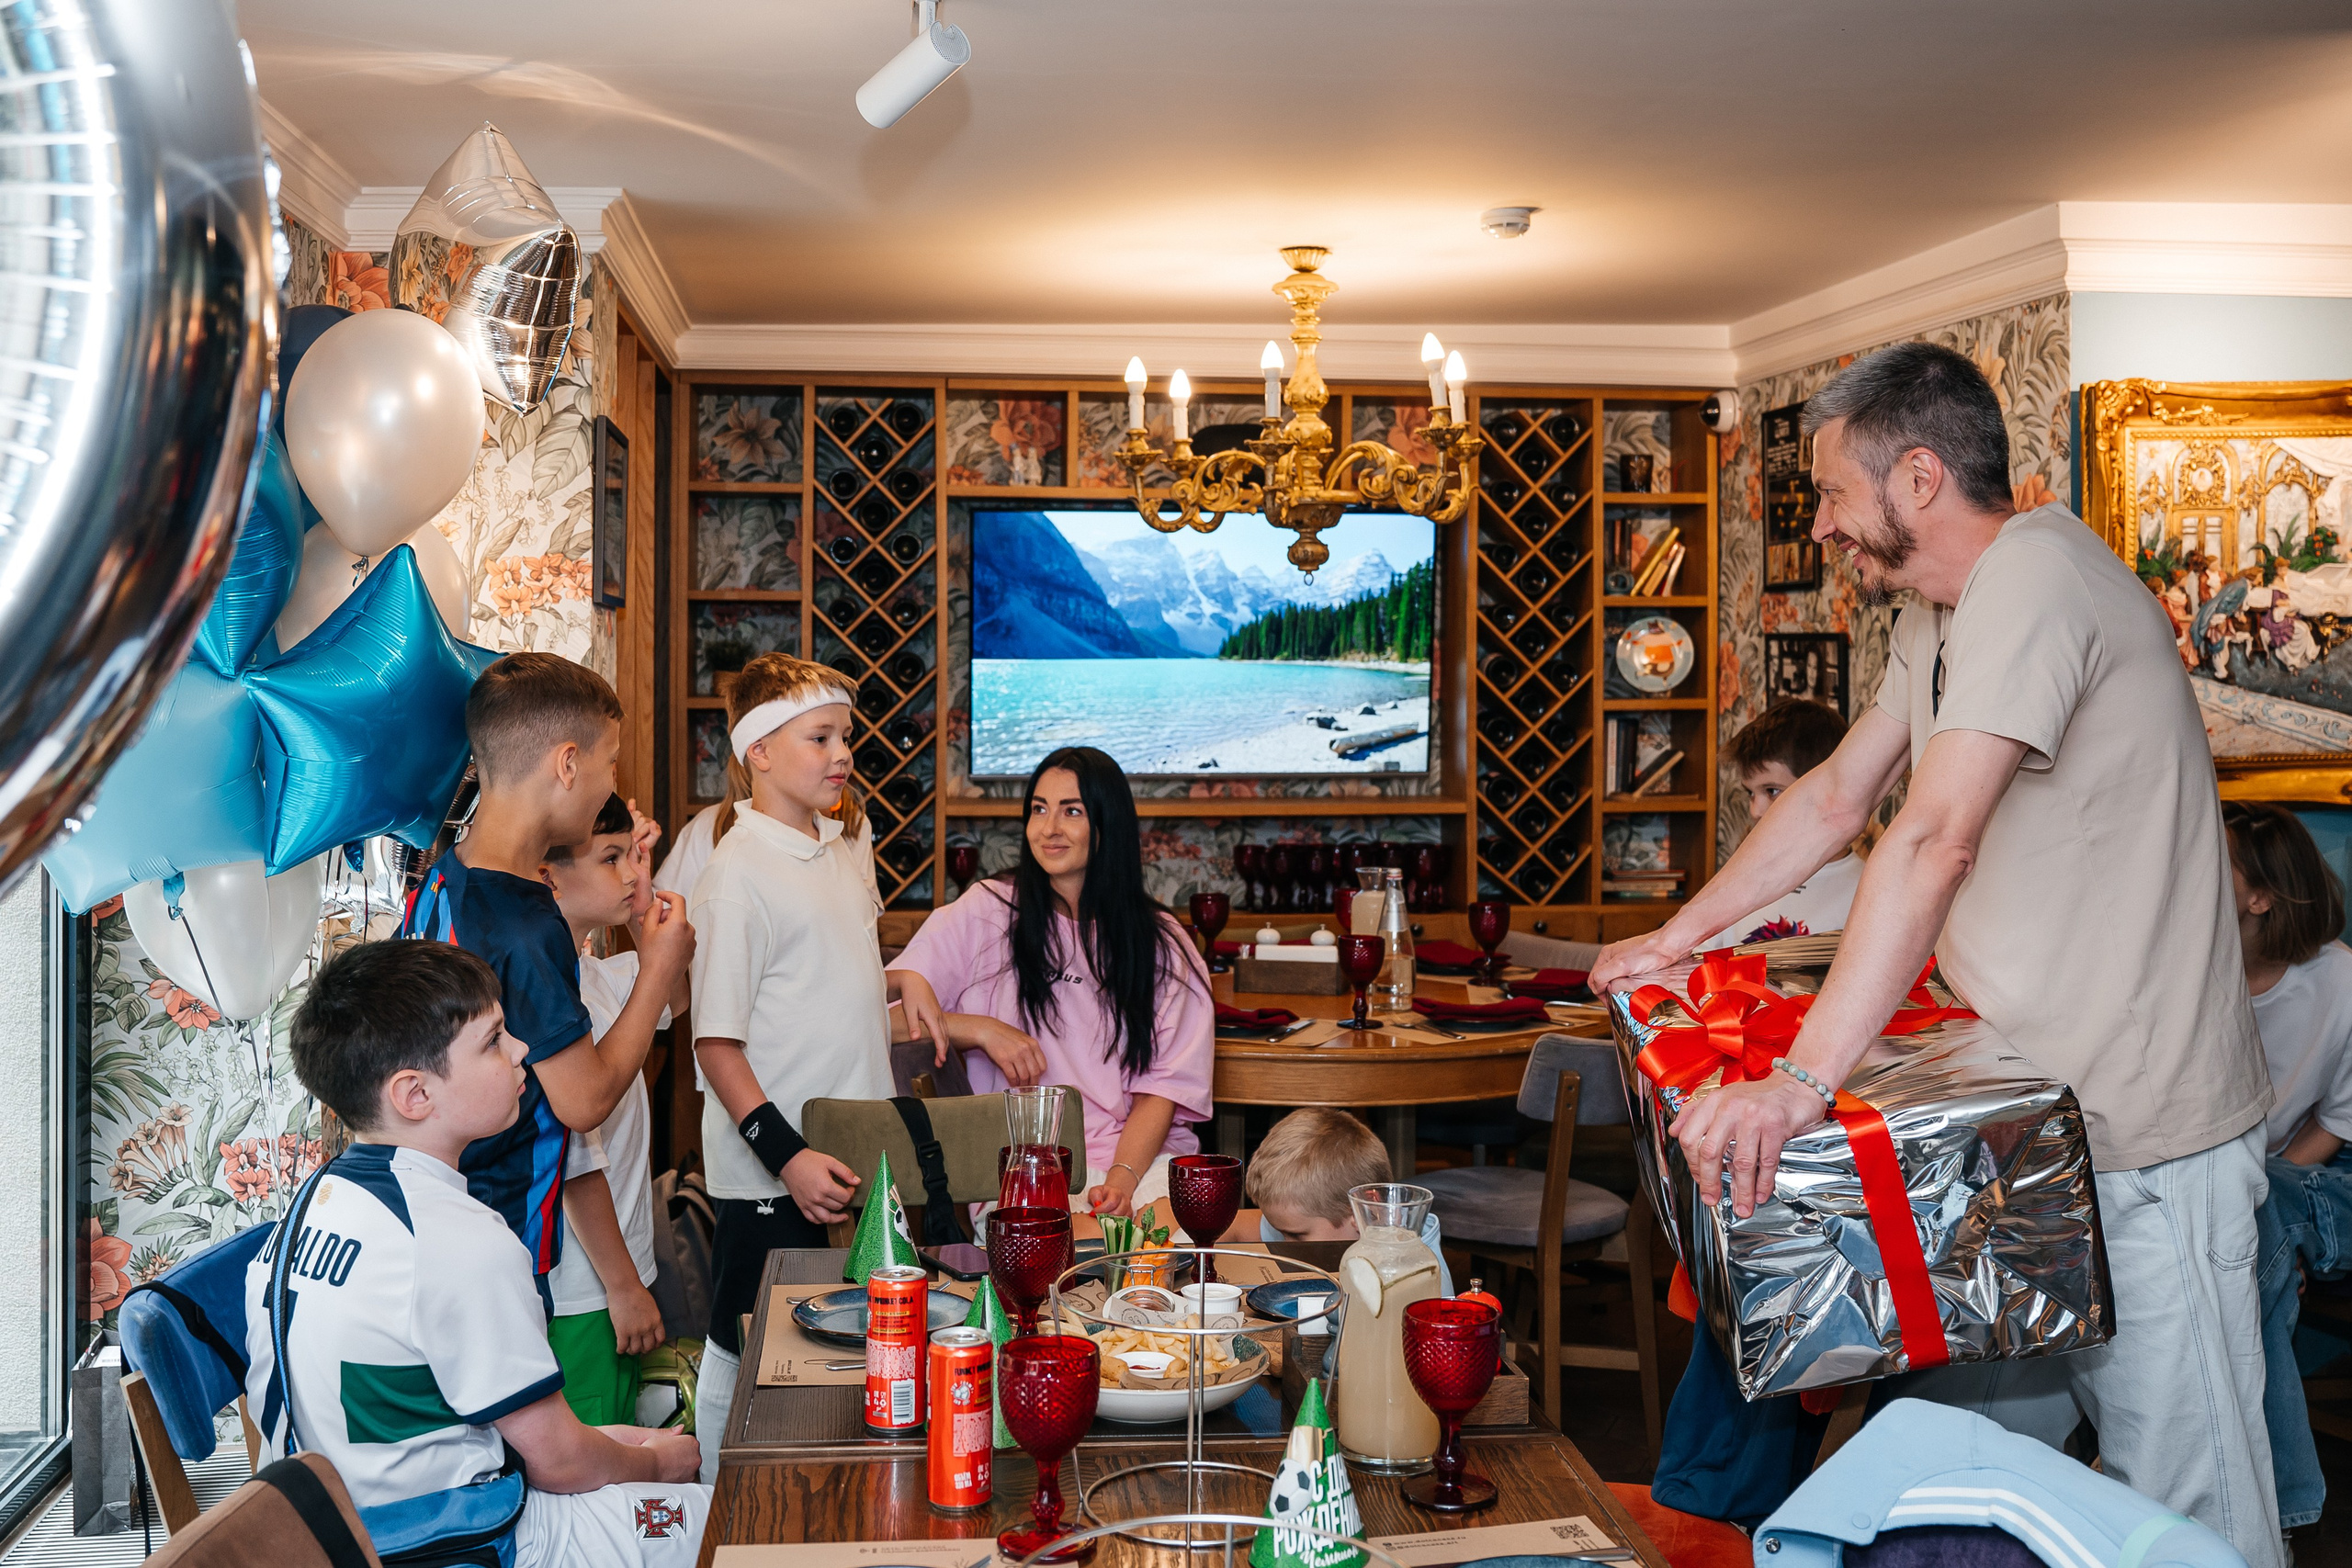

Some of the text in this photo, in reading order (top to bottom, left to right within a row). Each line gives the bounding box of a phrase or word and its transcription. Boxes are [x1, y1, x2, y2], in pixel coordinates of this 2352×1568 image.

[254, 1224, 362, 1288] OALDO
[1309, 1452, 1351, 1504] С ДН
